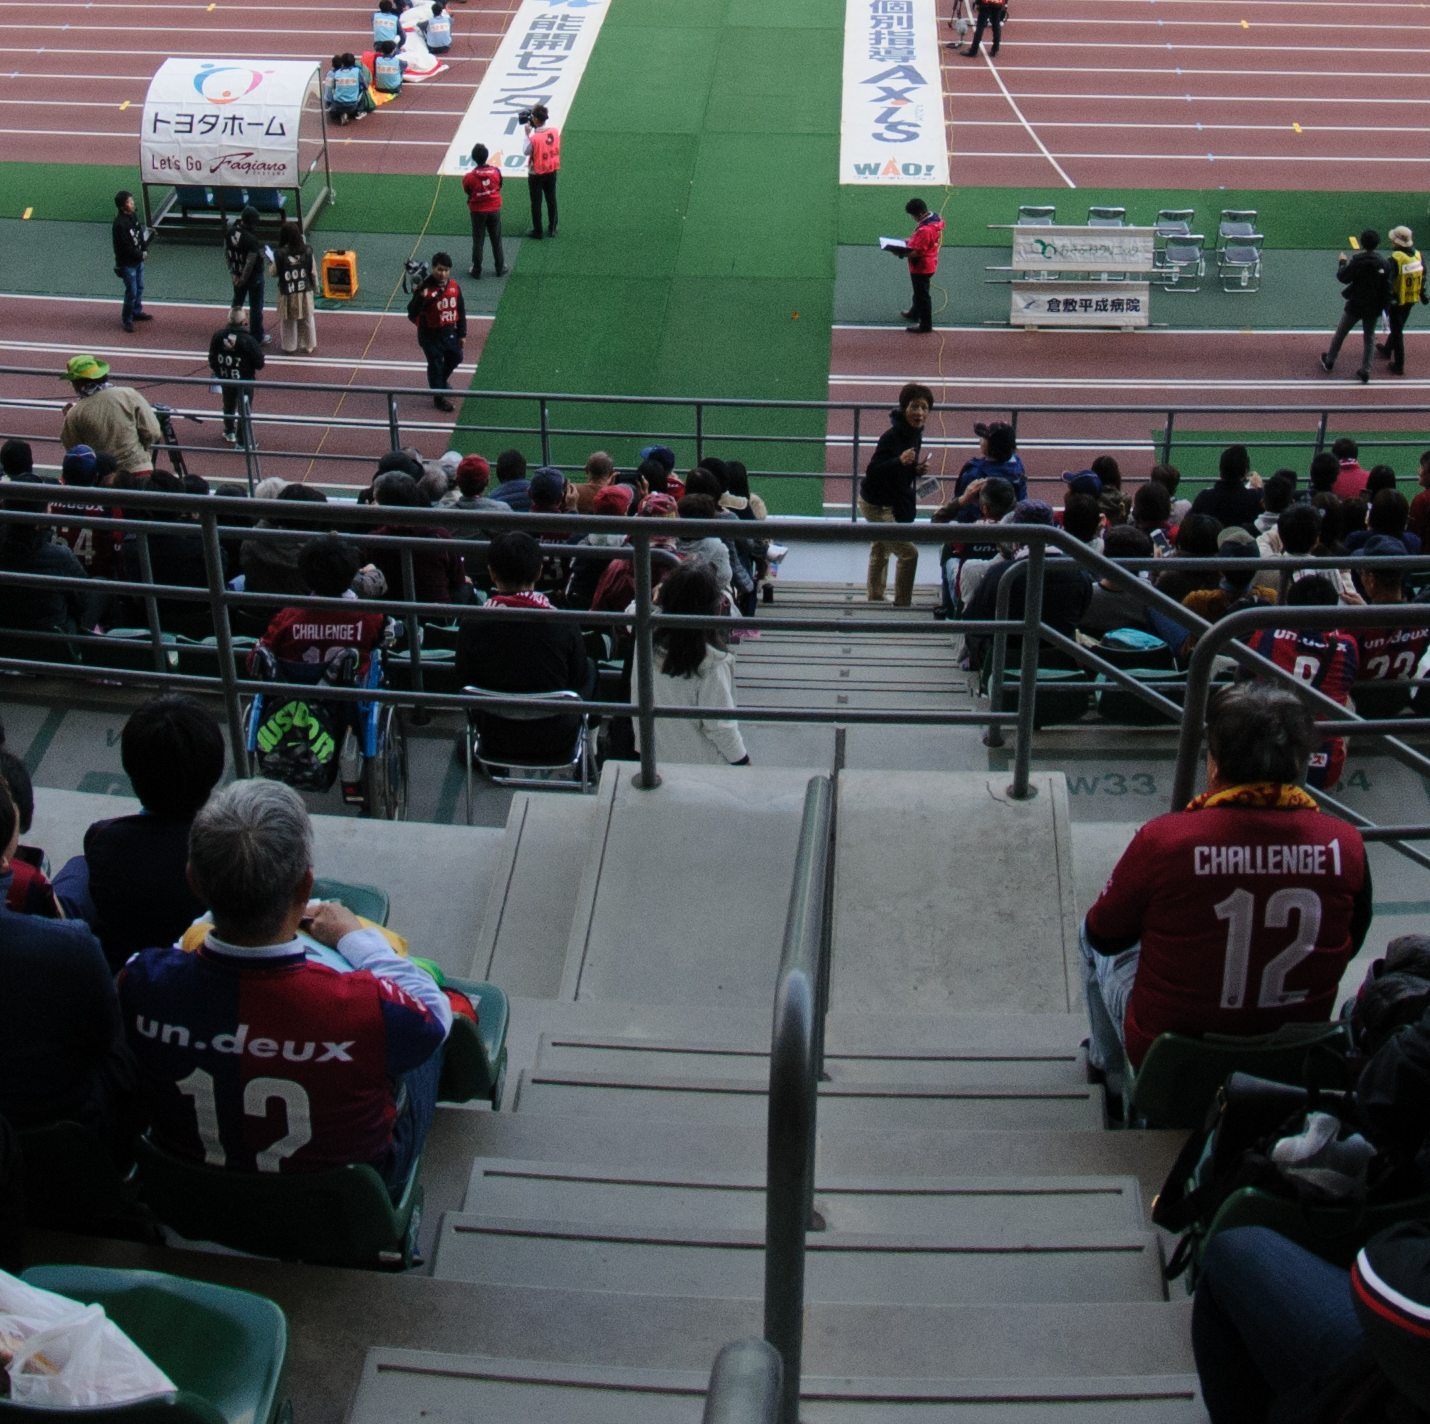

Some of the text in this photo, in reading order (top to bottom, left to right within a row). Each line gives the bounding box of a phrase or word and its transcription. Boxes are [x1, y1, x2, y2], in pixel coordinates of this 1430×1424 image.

[489, 13, 587, 138] 能開センター
[152, 112, 288, 138] トヨタホーム
[151, 151, 287, 174] Let's Go Fagiano
[853, 157, 936, 177] WAO!
[1046, 296, 1141, 314] 倉敷平成病院
[1065, 773, 1158, 797] W33
[1213, 887, 1323, 1010] 12
[135, 1012, 357, 1063] un.deux
[175, 1066, 313, 1173] 12
